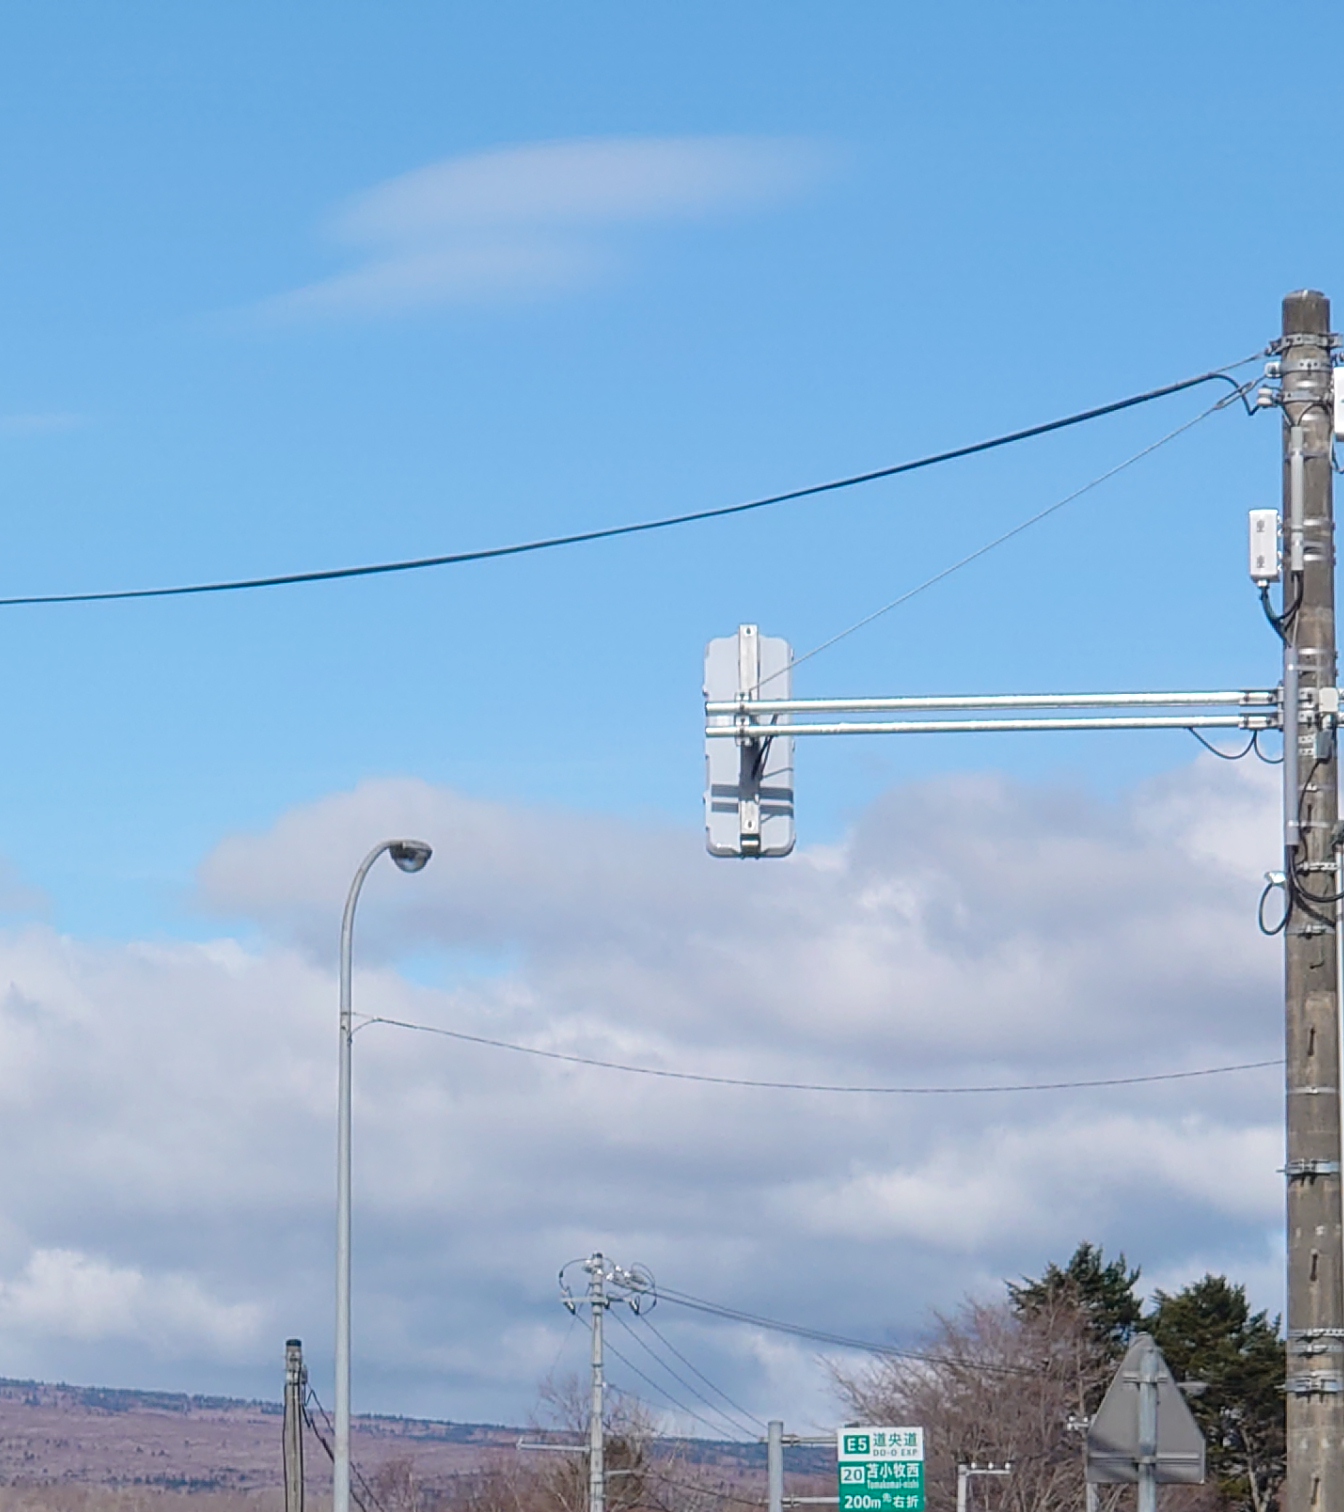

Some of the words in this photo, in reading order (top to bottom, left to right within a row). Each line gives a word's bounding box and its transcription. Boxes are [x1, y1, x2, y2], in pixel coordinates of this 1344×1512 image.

[847, 1438, 867, 1451] E5
[873, 1432, 918, 1447] 道央道
[843, 1469, 863, 1481] 20
[866, 1463, 920, 1478] 苫小牧西
